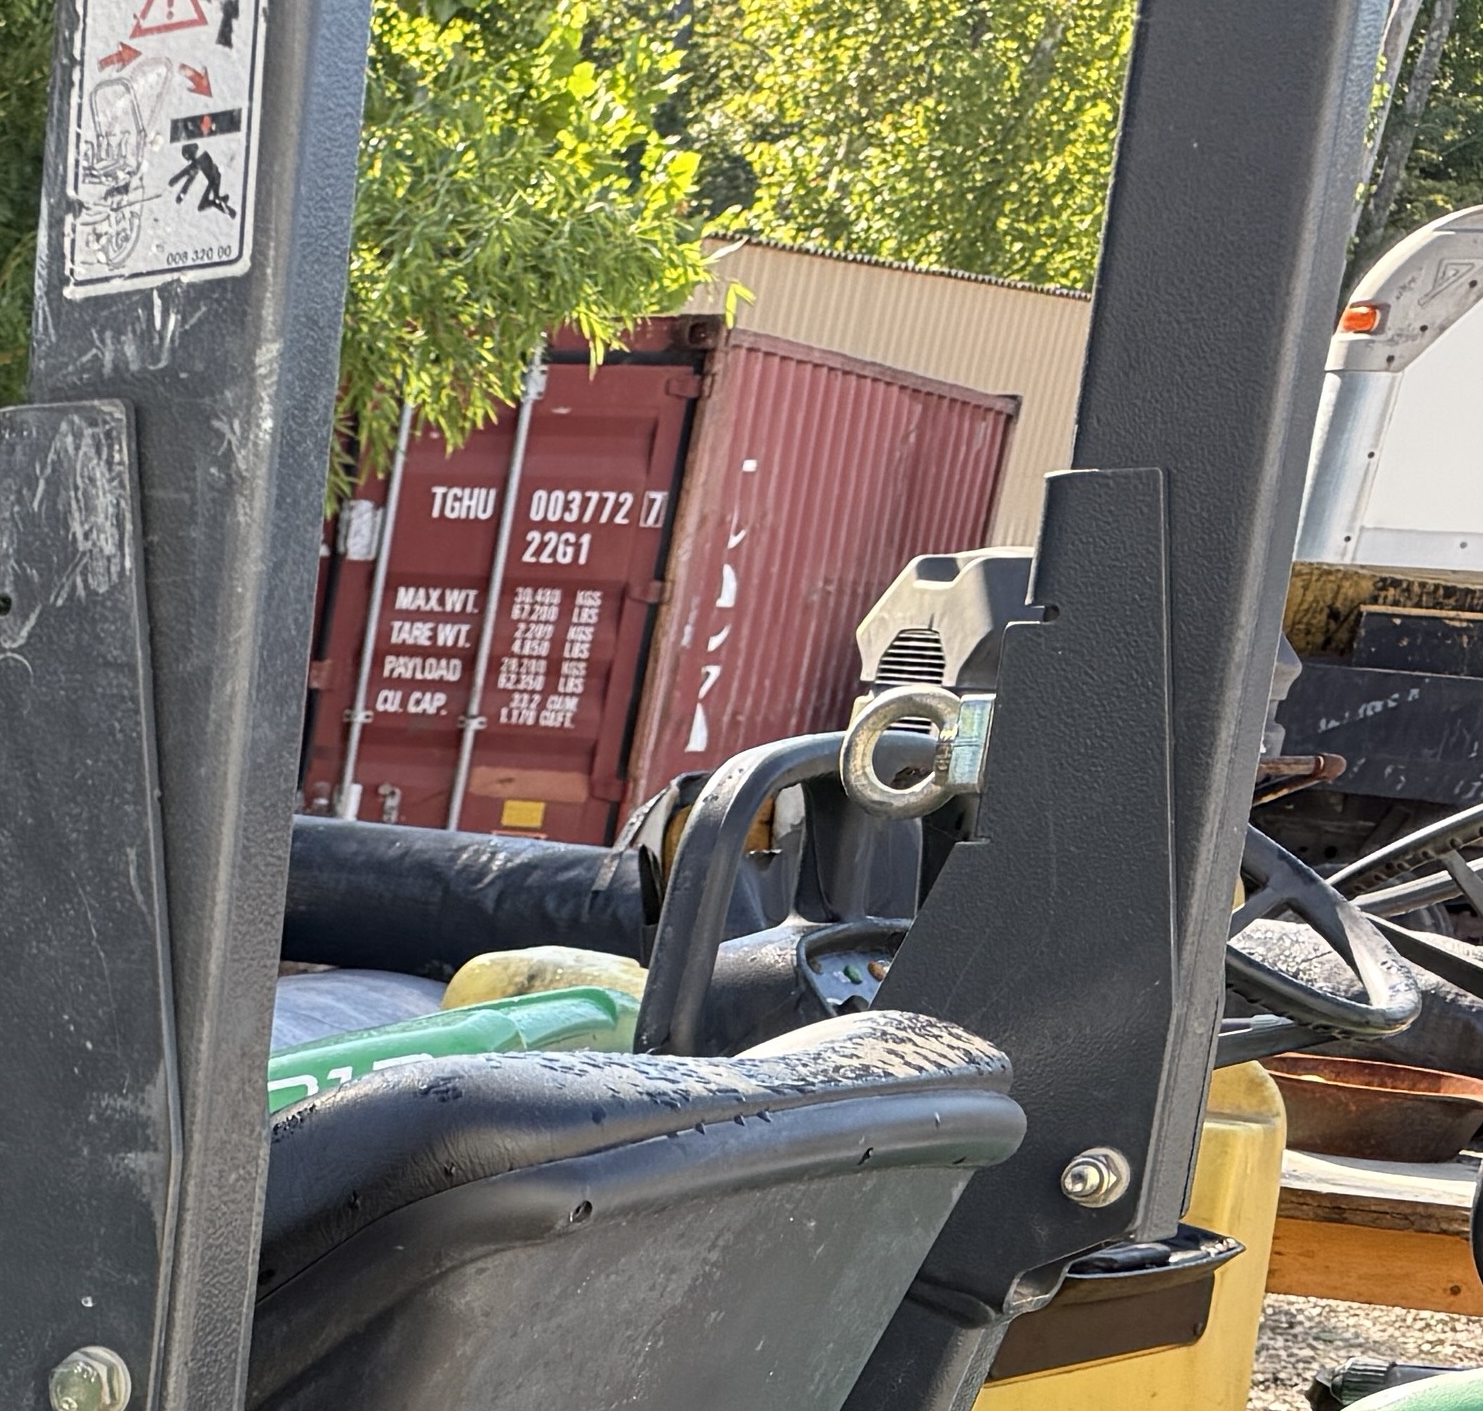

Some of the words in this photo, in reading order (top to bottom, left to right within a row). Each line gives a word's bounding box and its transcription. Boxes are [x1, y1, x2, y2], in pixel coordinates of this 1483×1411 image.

[431, 486, 496, 520] TGHU
[529, 489, 634, 525] 003772
[643, 492, 667, 526] 7
[521, 530, 592, 565] 22G1
[572, 606, 600, 624] LBS
[391, 620, 436, 646] TARE
[437, 622, 472, 648] WT.
[563, 641, 591, 659] LBS
[383, 655, 462, 682] PAYLOAD
[557, 675, 585, 694] LBS
[375, 689, 403, 713] CU.
[407, 690, 448, 716] CAP.
